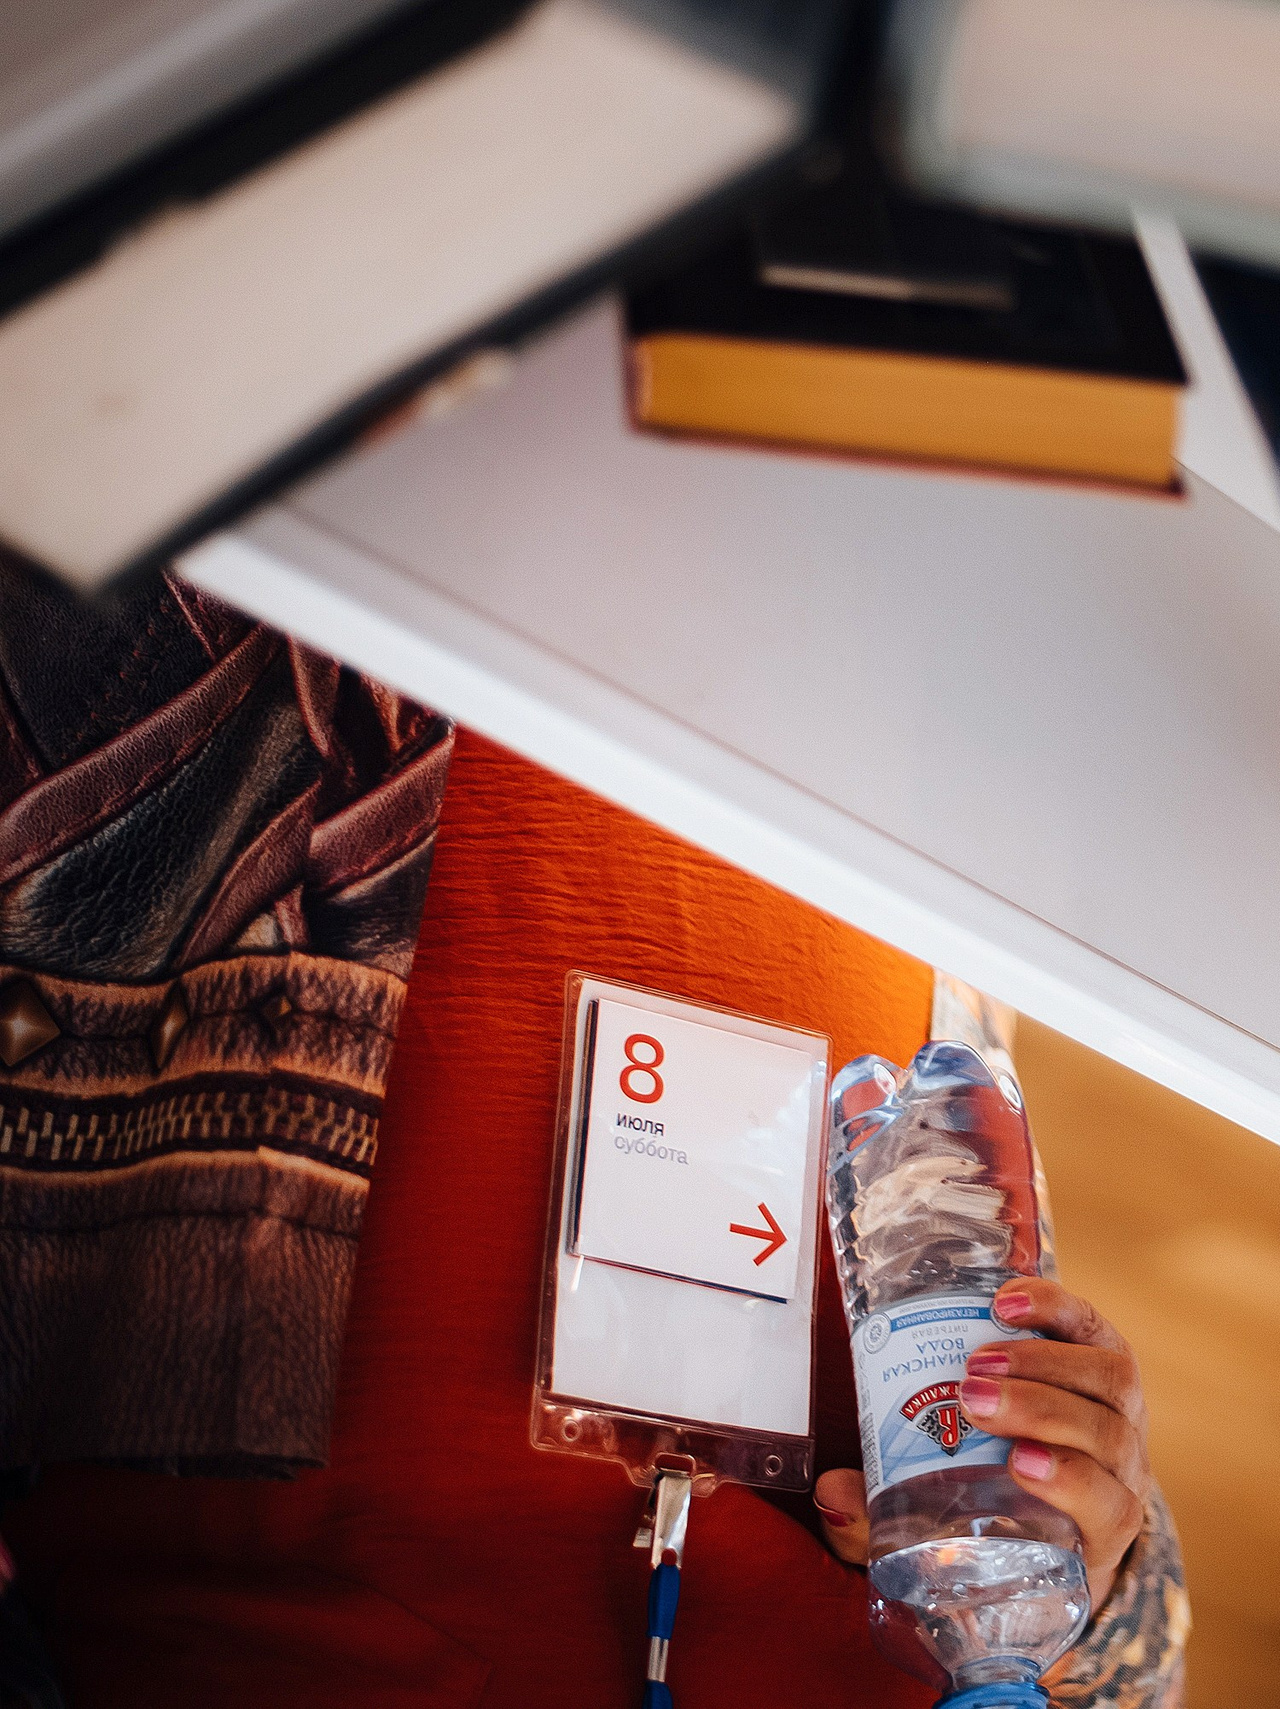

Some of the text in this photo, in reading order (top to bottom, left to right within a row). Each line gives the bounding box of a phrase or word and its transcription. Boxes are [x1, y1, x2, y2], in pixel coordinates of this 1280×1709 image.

[619, 1033, 665, 1104] 8
[615, 1111, 665, 1137] июля
[613, 1135, 690, 1167] суббота
[894, 1307, 981, 1329] НЕГАЗИРОВАННАЯ
[910, 1323, 969, 1340] ПИТЬЕВАЯ
[915, 1337, 966, 1355] ВОДА
[881, 1350, 972, 1384] ЗИАНСКАЯ
